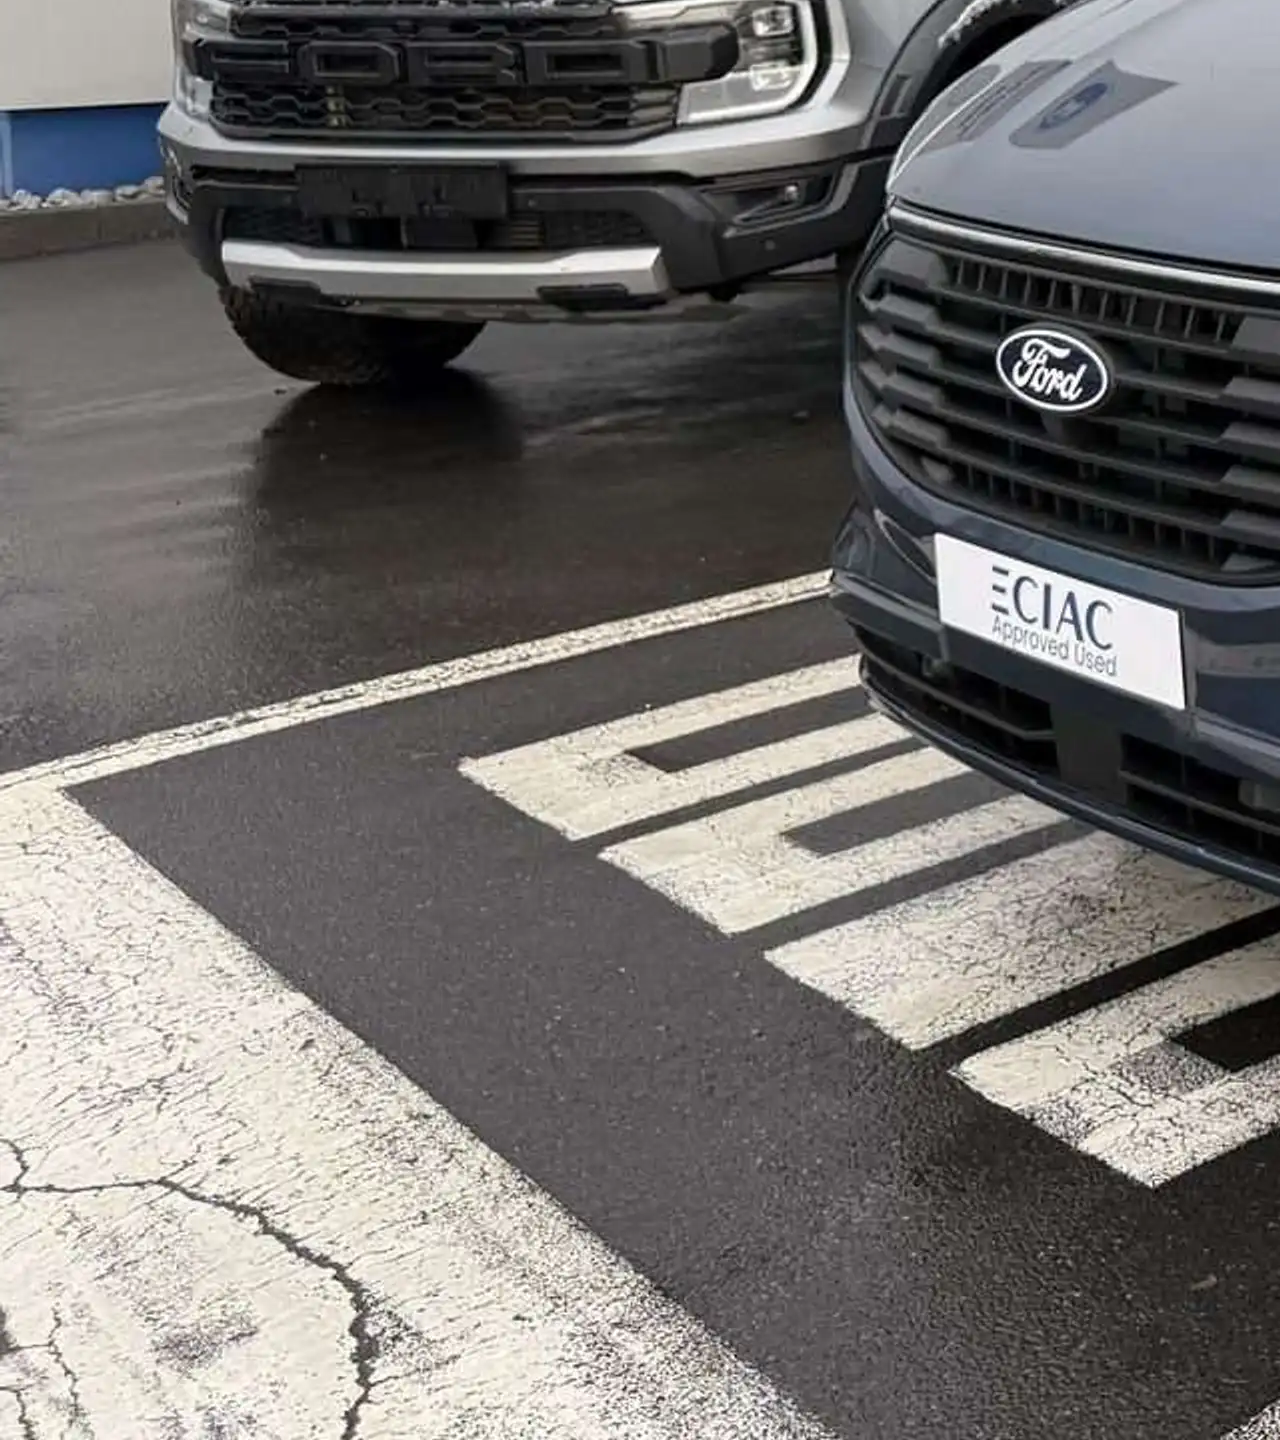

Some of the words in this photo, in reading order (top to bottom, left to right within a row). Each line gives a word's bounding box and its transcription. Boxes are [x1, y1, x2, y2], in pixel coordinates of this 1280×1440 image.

[1012, 337, 1087, 401] Ford
[990, 564, 1115, 651] ECIAC
[990, 614, 1070, 661] Approved
[1073, 639, 1119, 678] Used
